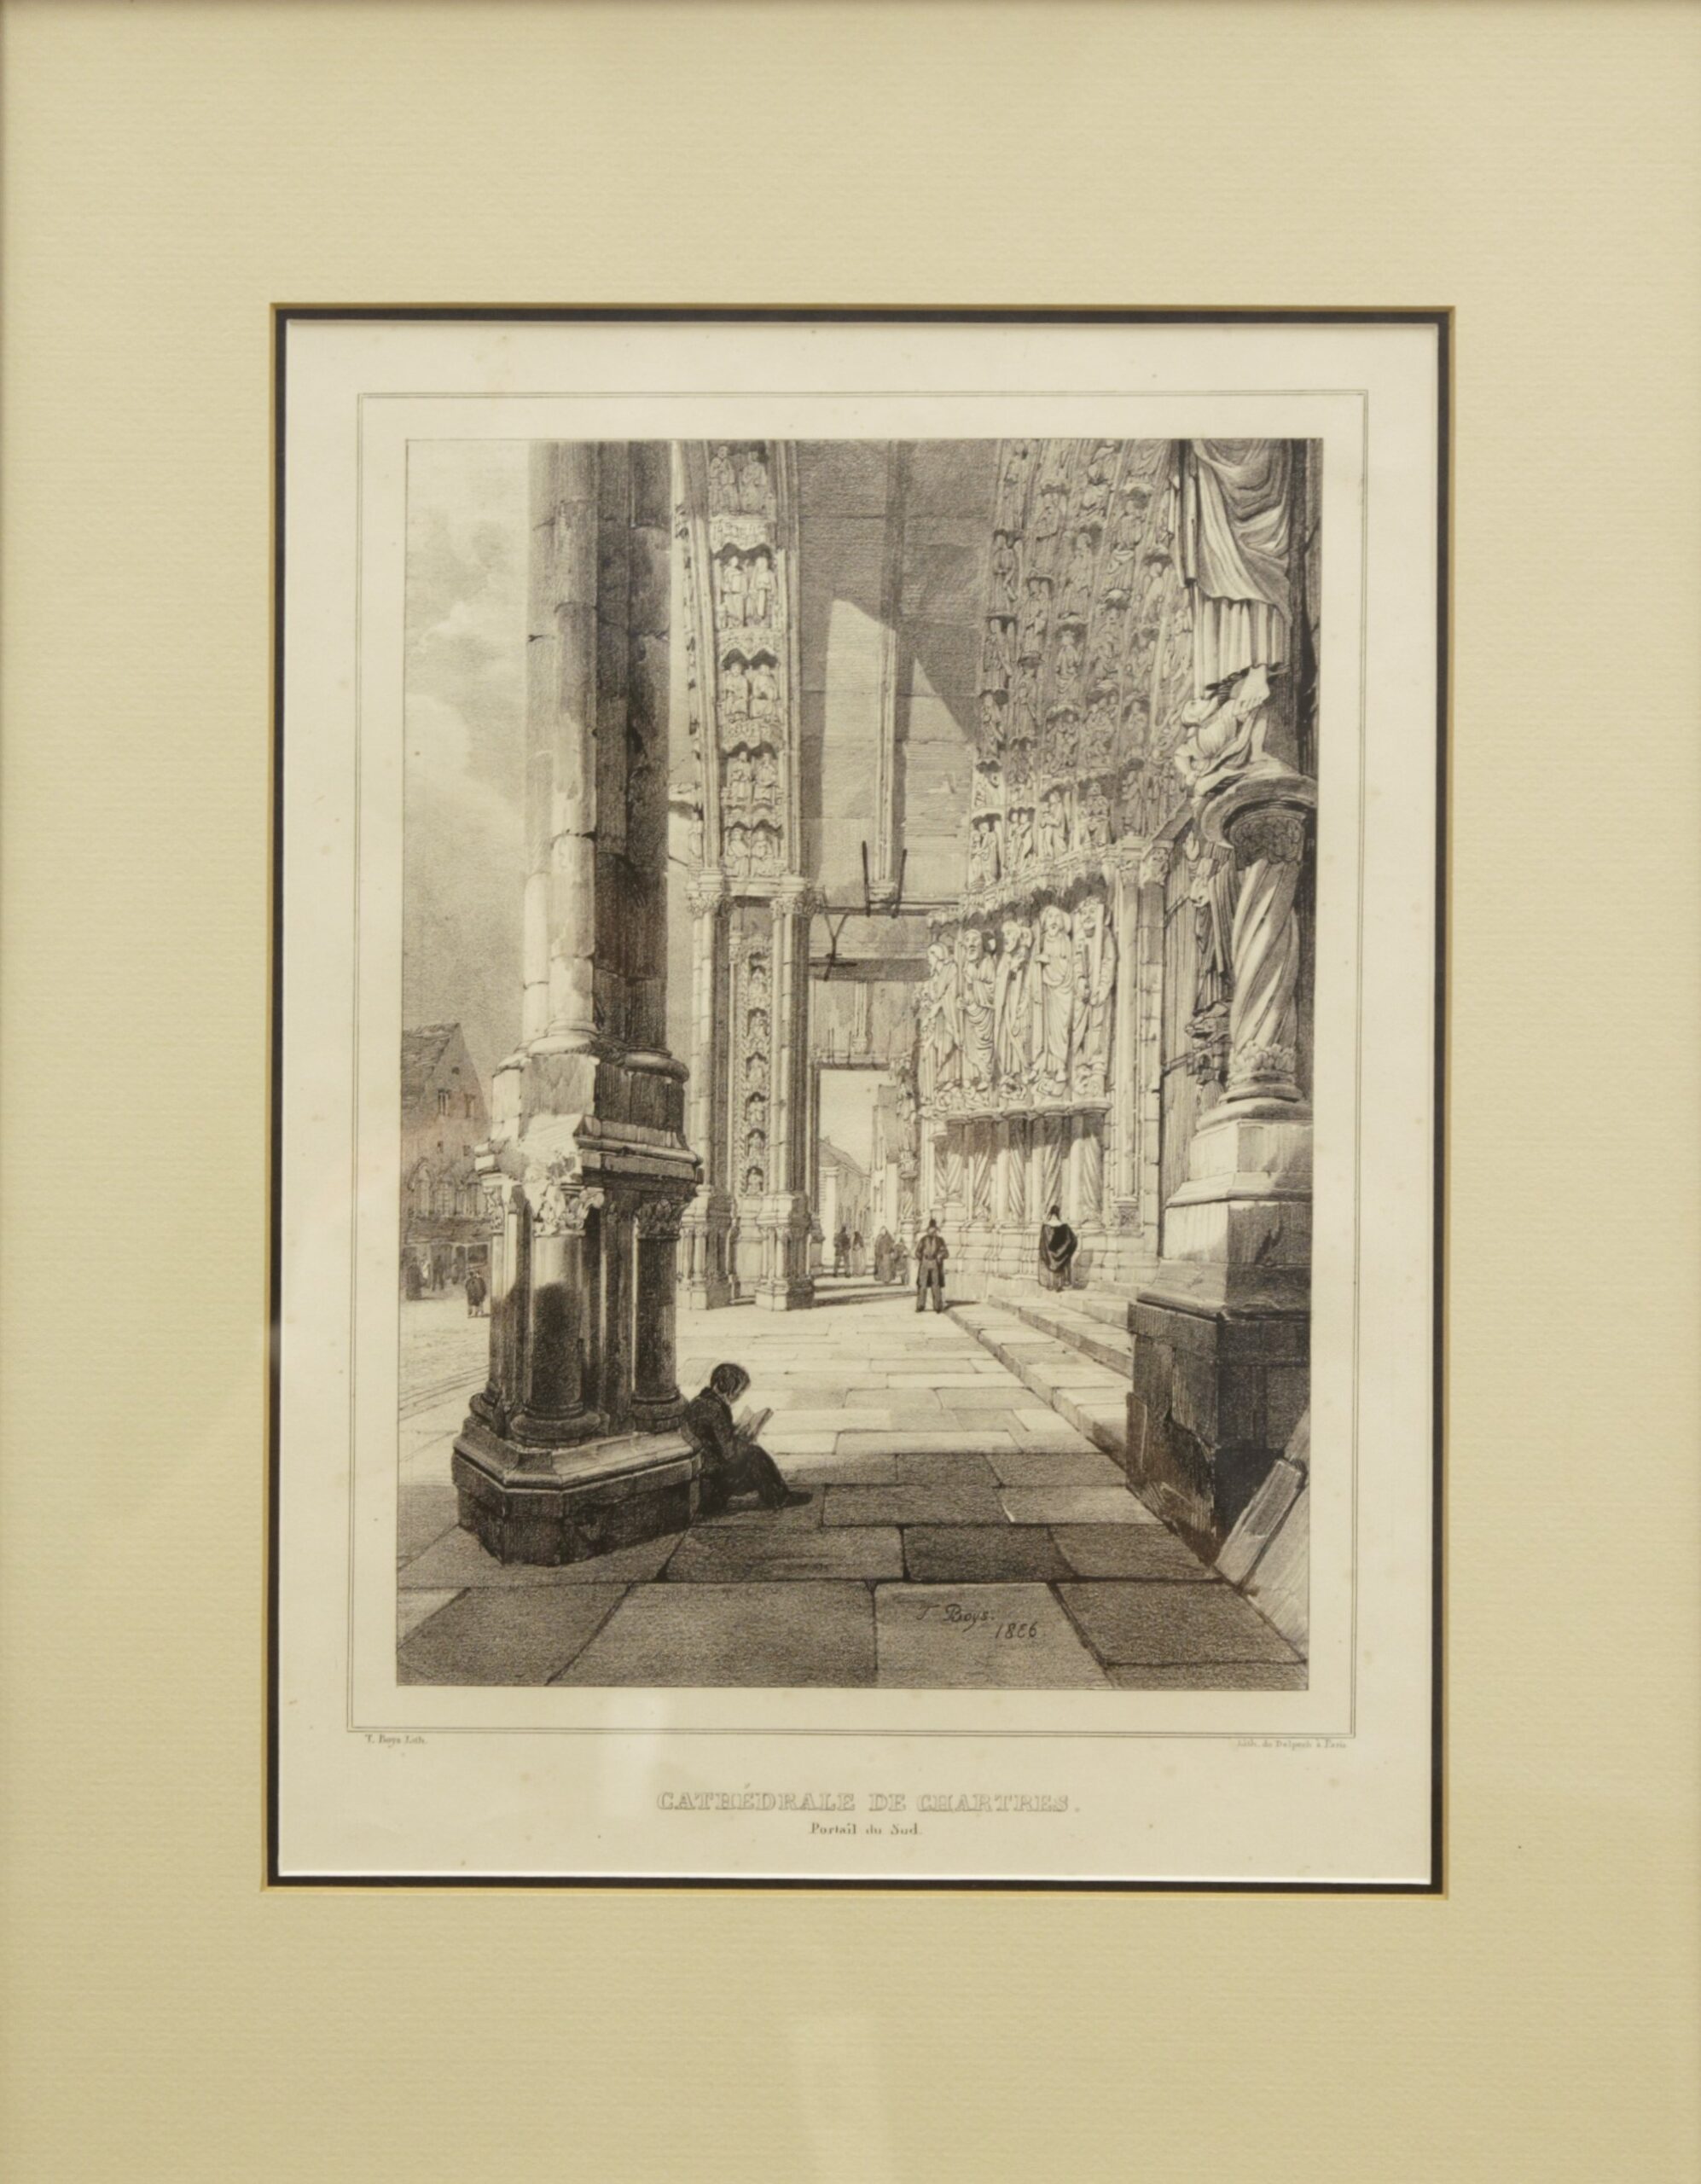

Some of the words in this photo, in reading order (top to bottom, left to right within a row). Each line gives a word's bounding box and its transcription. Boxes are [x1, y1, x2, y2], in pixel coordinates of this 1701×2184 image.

[656, 1781, 856, 1812] CATHÉDRALE
[868, 1792, 907, 1813] DE
[915, 1793, 1081, 1814] CHARTRES.
[810, 1821, 856, 1835] Portail
[865, 1823, 882, 1835] du
